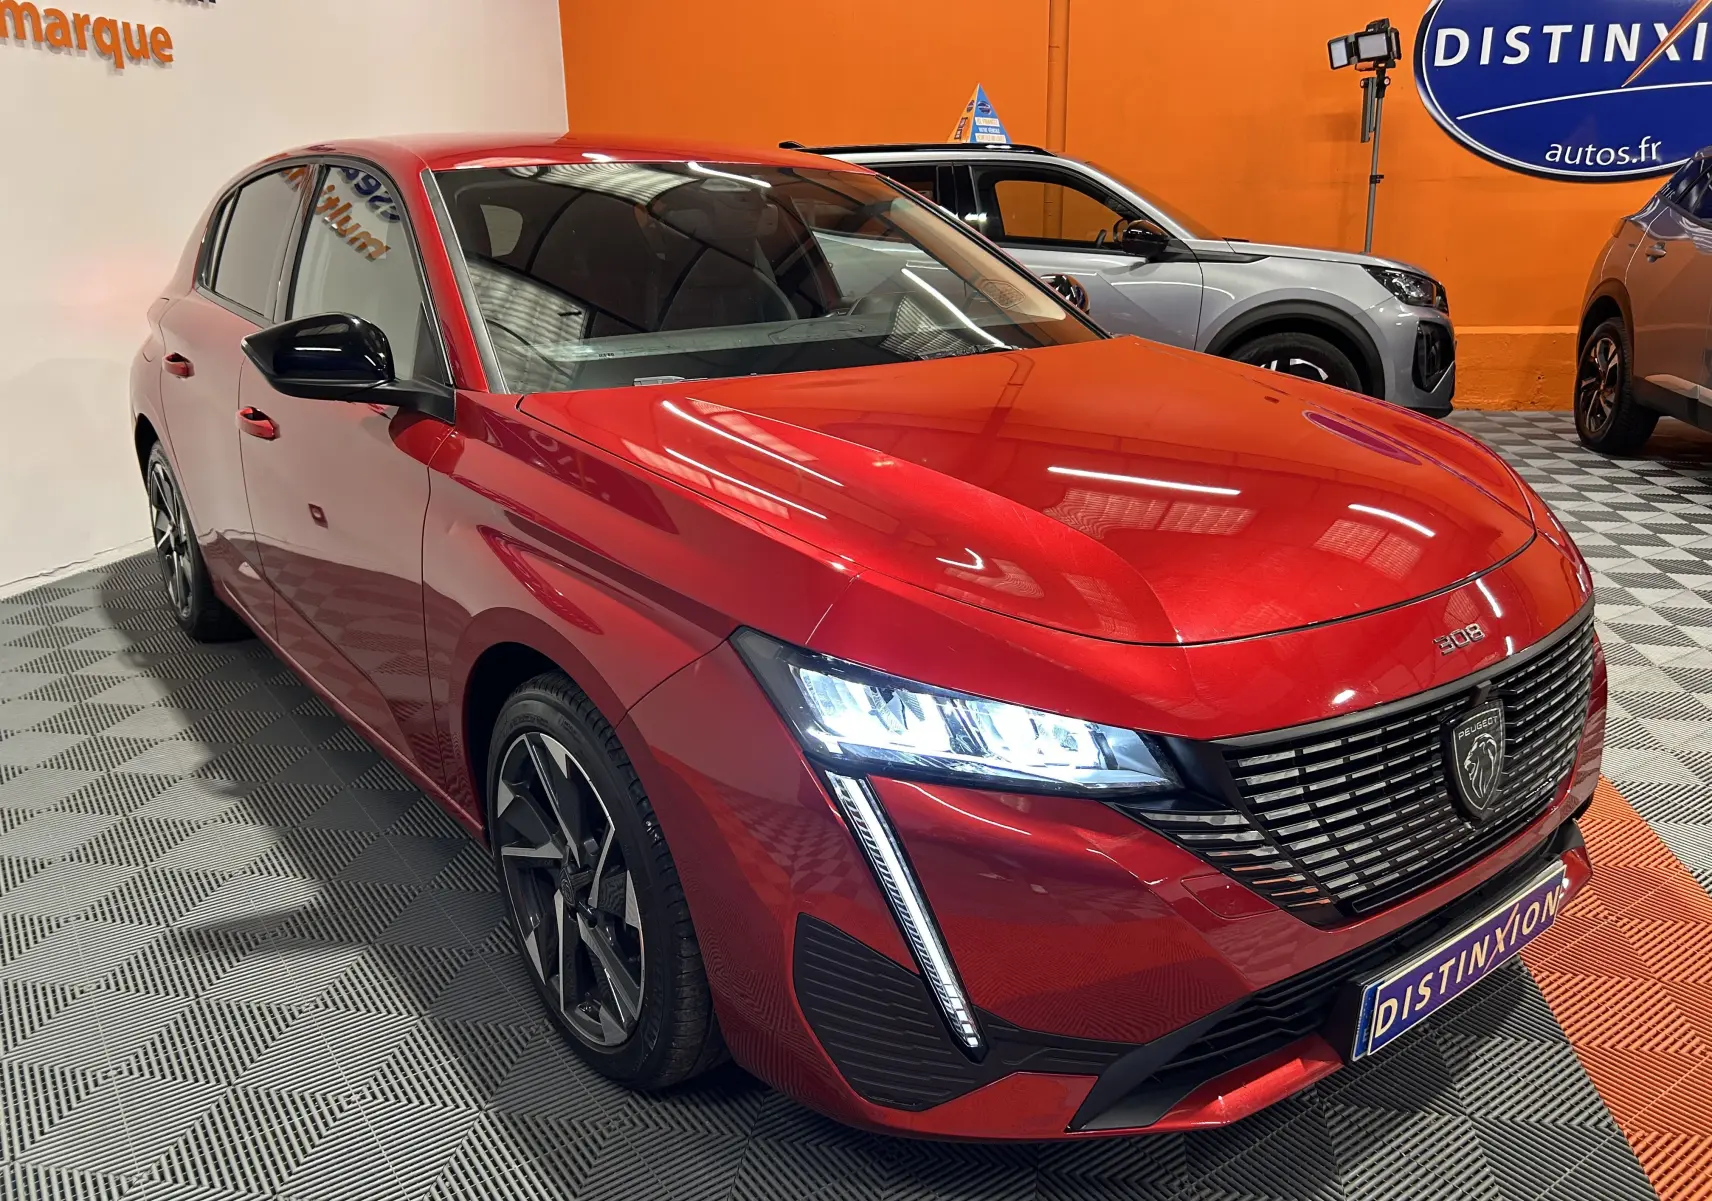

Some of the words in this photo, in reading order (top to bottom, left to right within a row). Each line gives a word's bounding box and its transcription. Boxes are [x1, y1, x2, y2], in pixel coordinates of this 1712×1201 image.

[0, 0, 174, 69] marque
[1544, 136, 1662, 166] autos.fr
[1433, 623, 1486, 656] 308
[1458, 715, 1499, 740] PEUGEOT
[1374, 885, 1561, 1039] DISTINXION
